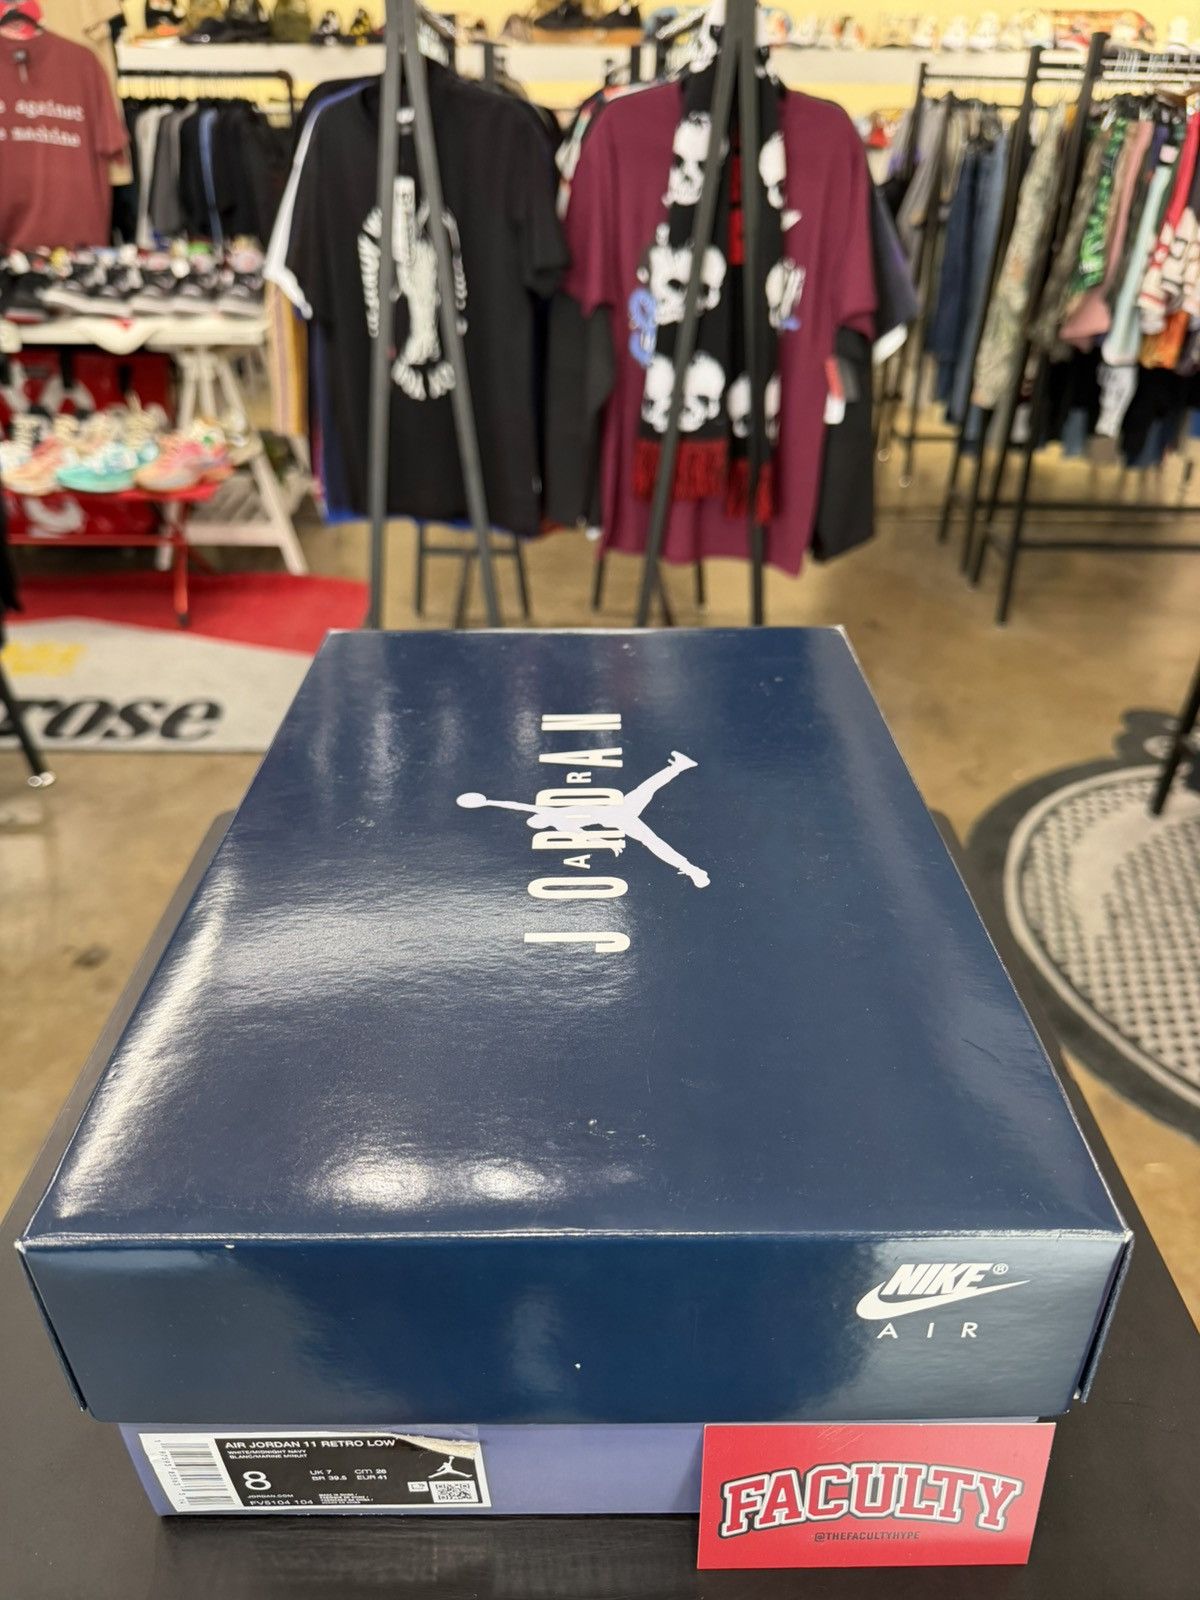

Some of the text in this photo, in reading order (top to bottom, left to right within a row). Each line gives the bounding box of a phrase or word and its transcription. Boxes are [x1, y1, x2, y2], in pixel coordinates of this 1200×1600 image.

[524, 713, 631, 953] JORDAN
[877, 1322, 979, 1339] AIR
[225, 1439, 396, 1449] AIR JORDAN 11 RETRO LOW
[242, 1470, 272, 1491] 8
[719, 1462, 1025, 1539] FACULTY
[813, 1531, 921, 1542] @THEFACULTYHYPE
